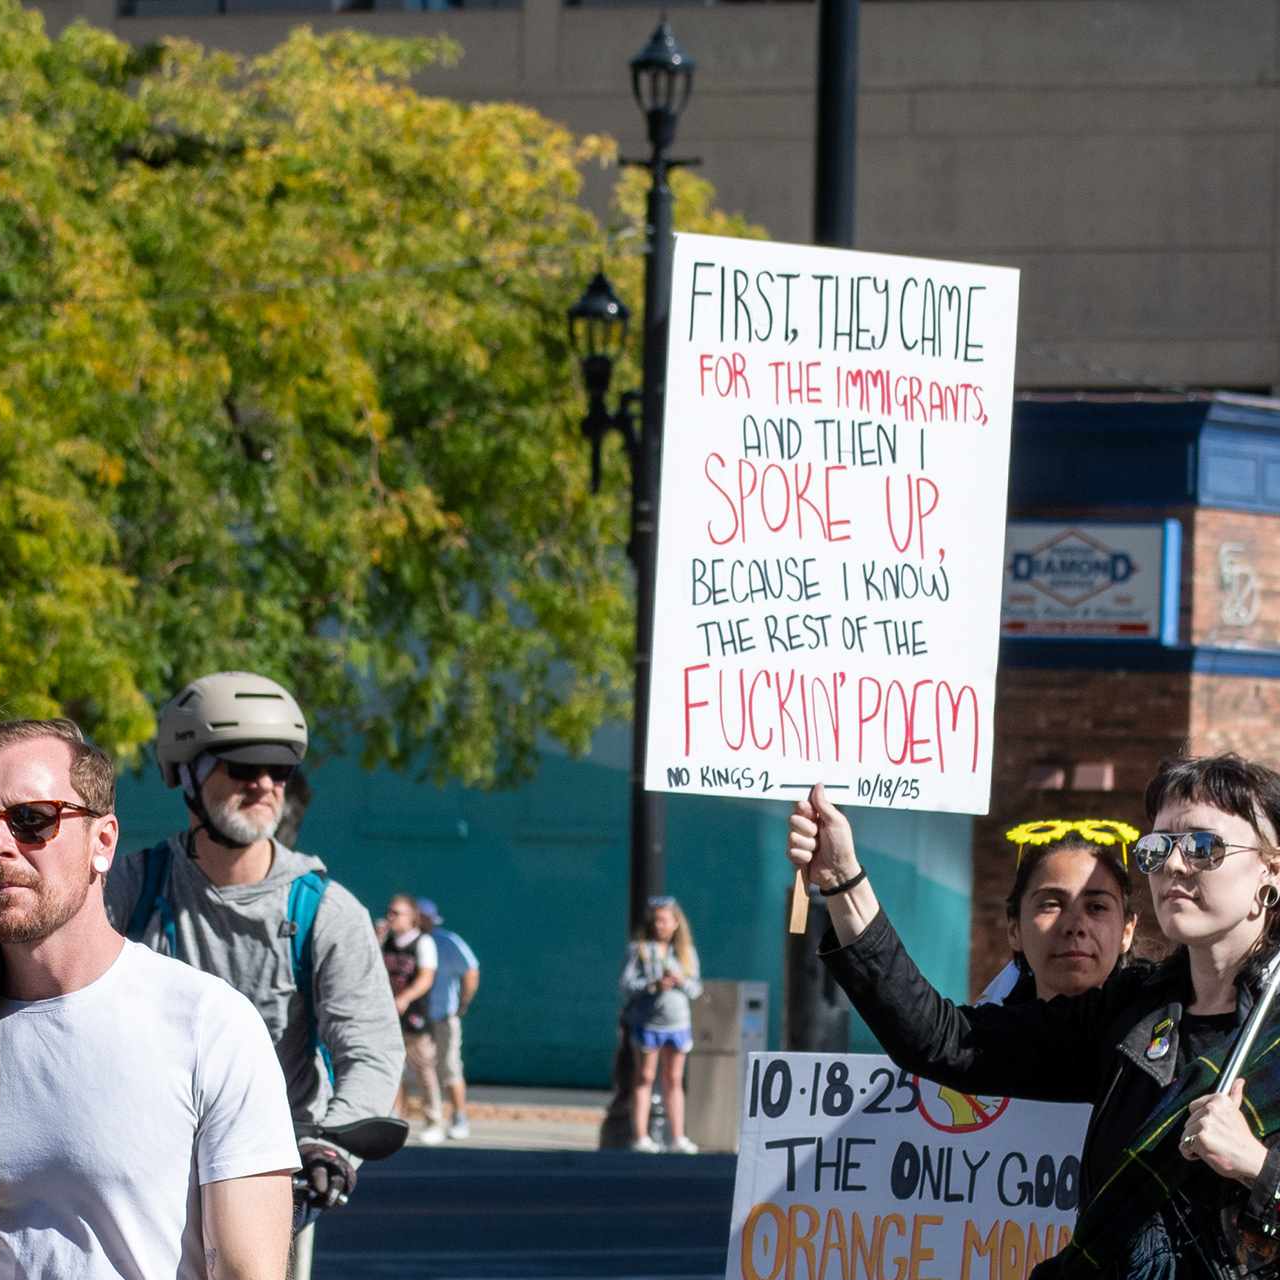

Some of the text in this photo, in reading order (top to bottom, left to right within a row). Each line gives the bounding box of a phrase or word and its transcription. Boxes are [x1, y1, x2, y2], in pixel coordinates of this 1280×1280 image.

[689, 262, 987, 362] FIRST, THEY CAME
[700, 352, 988, 426] FOR THE IMMIGRANTS,
[743, 415, 925, 470] AND THEN I
[705, 452, 945, 564] SPOKE UP,
[692, 557, 949, 605] BECAUSE I KNOW
[696, 614, 928, 656] THE REST OF THE
[684, 663, 979, 773] FUCKIN' POEM
[667, 765, 920, 806] NO KINGS 2 10/18/25
[765, 1137, 1080, 1211] THE ONLY GOO
